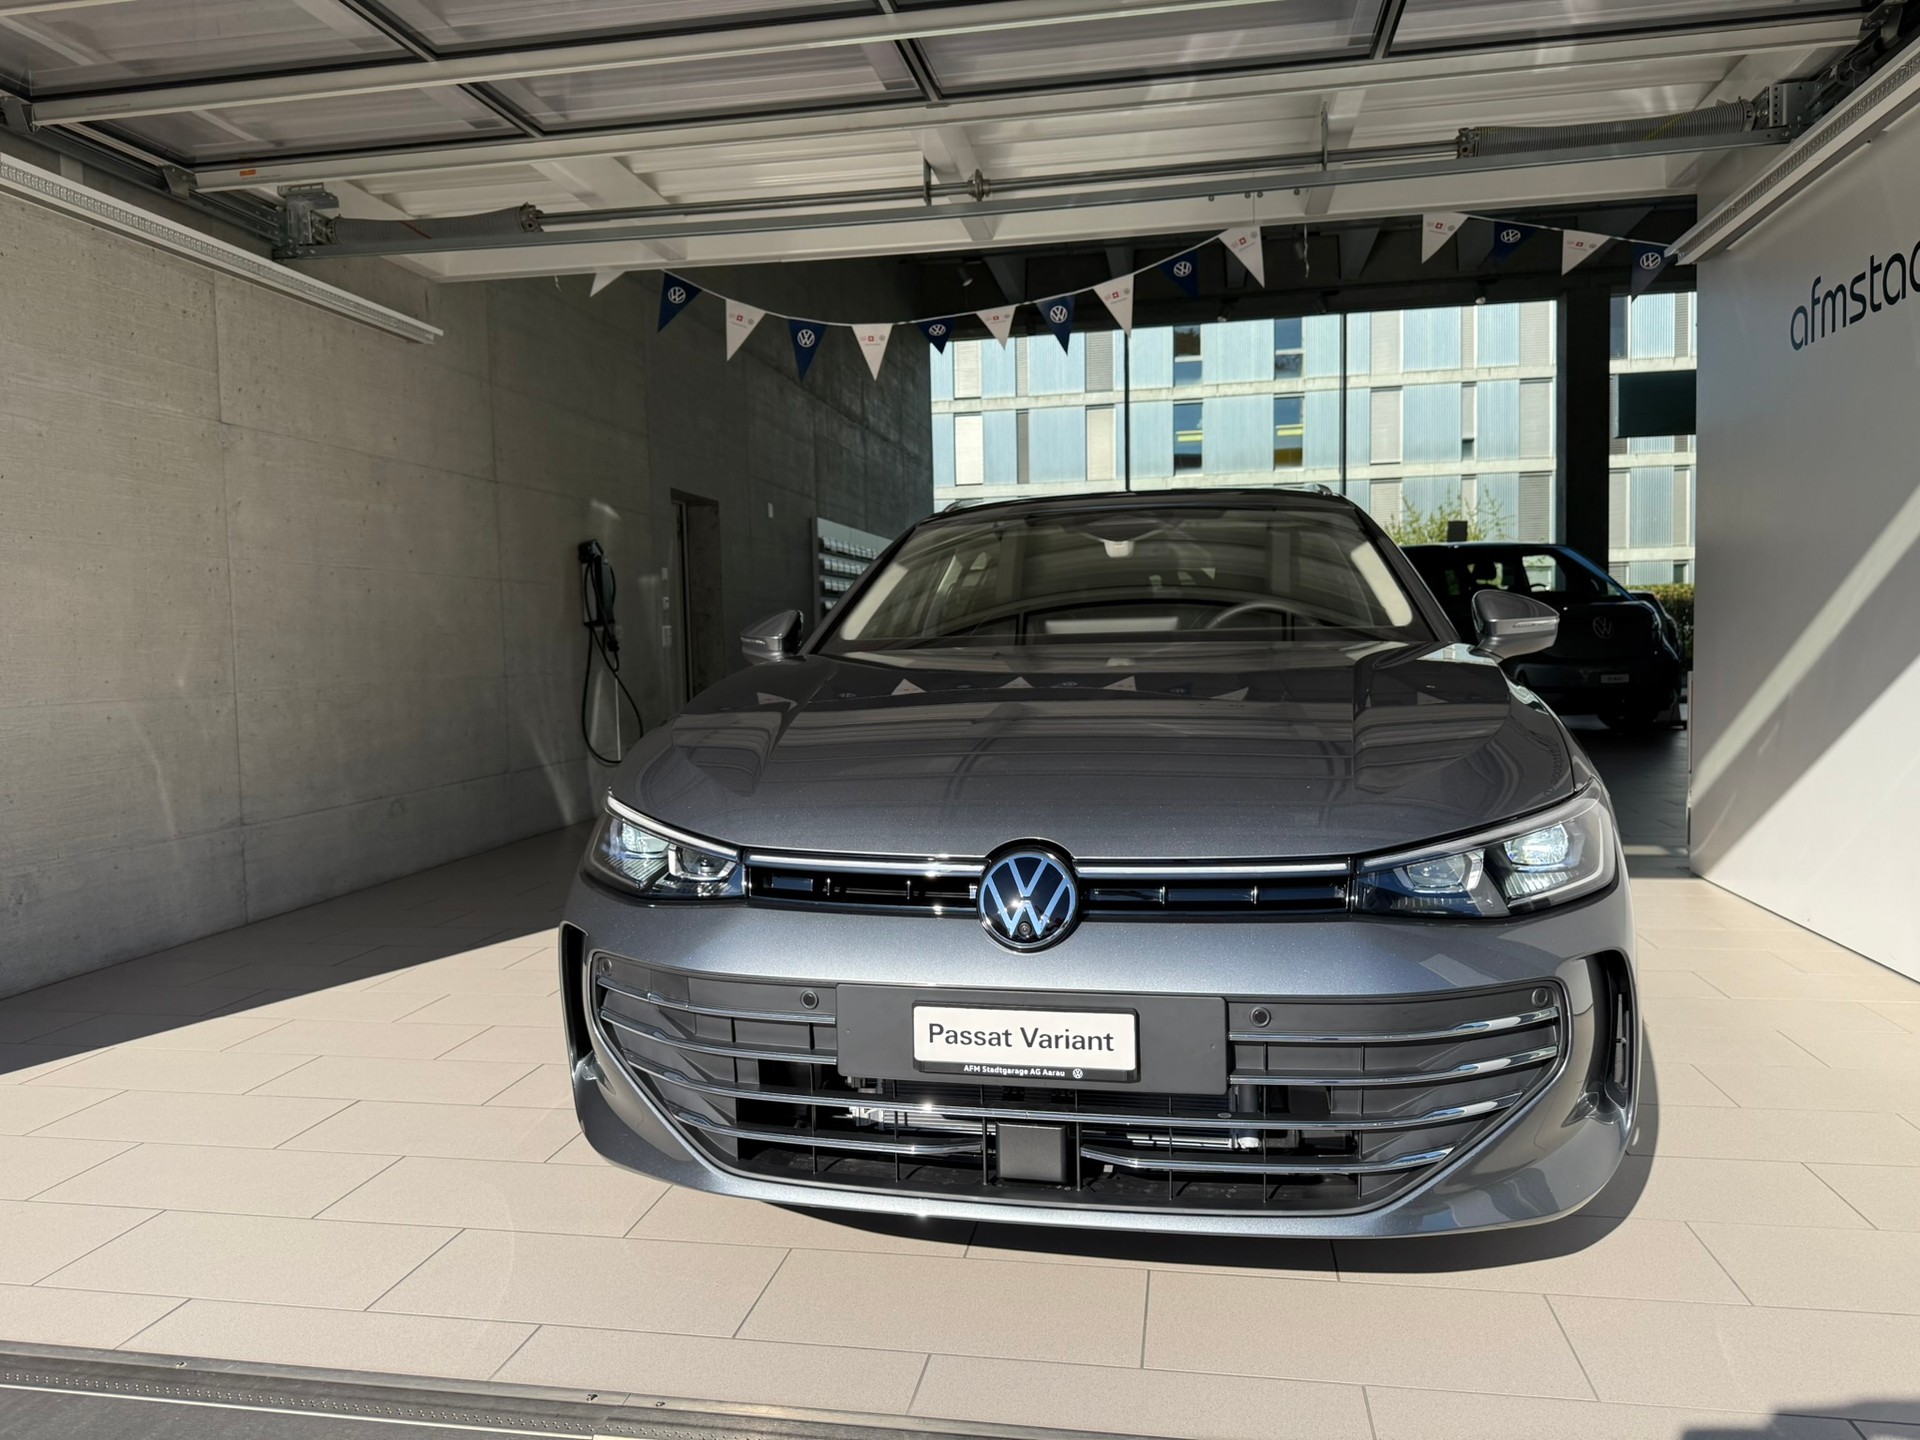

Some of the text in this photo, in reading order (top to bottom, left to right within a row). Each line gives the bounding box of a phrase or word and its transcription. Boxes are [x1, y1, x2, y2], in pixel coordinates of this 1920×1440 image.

[983, 854, 1072, 943] VW
[928, 1023, 1115, 1052] Passat Variant
[963, 1064, 981, 1073] AFM
[982, 1065, 1029, 1076] Stadtgarage
[1029, 1068, 1041, 1076] AG
[1042, 1069, 1066, 1077] Aarau
